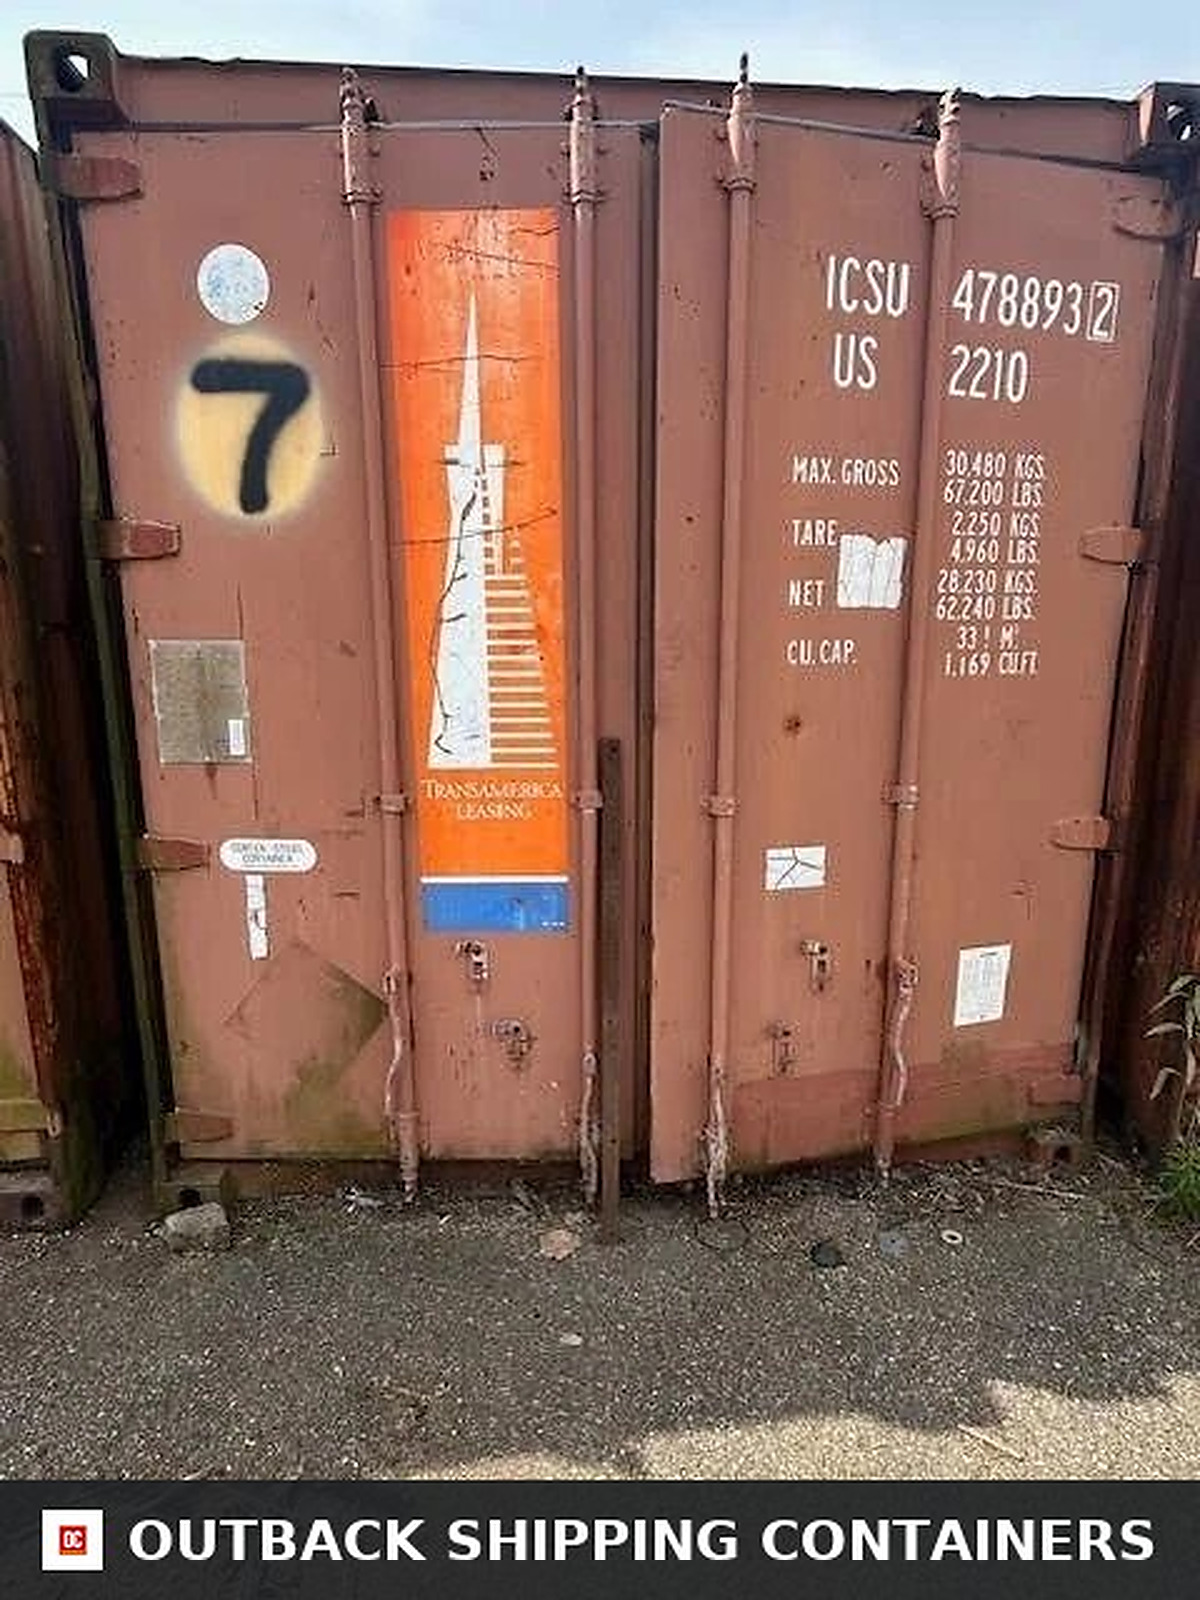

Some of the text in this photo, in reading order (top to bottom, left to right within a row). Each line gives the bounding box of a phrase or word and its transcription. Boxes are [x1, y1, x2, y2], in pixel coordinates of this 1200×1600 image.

[826, 255, 909, 317] ICSU
[833, 333, 1028, 402] US 2210
[190, 359, 311, 514] 7
[842, 458, 900, 486] GROSS
[792, 519, 838, 546] TARE
[789, 580, 825, 606] NET
